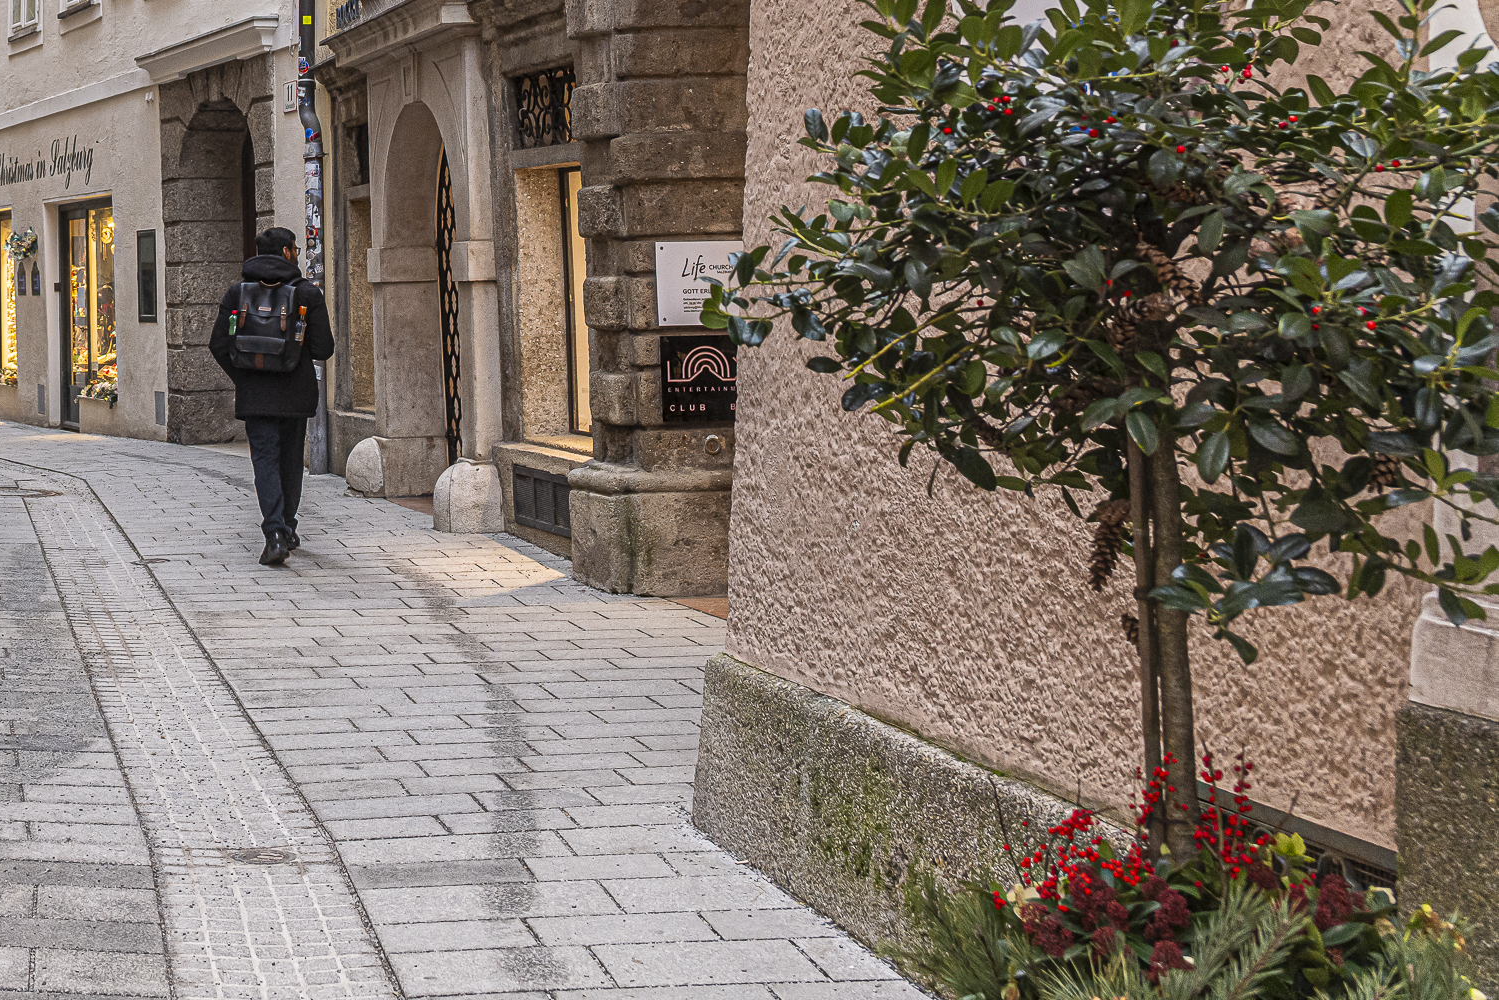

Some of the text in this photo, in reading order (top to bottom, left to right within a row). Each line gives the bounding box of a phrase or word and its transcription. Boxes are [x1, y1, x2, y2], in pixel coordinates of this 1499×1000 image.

[287, 84, 293, 101] 11
[36, 150, 46, 179] in
[50, 135, 94, 190] Salzburg
[682, 255, 706, 281] Life
[670, 403, 706, 412] CLUB
